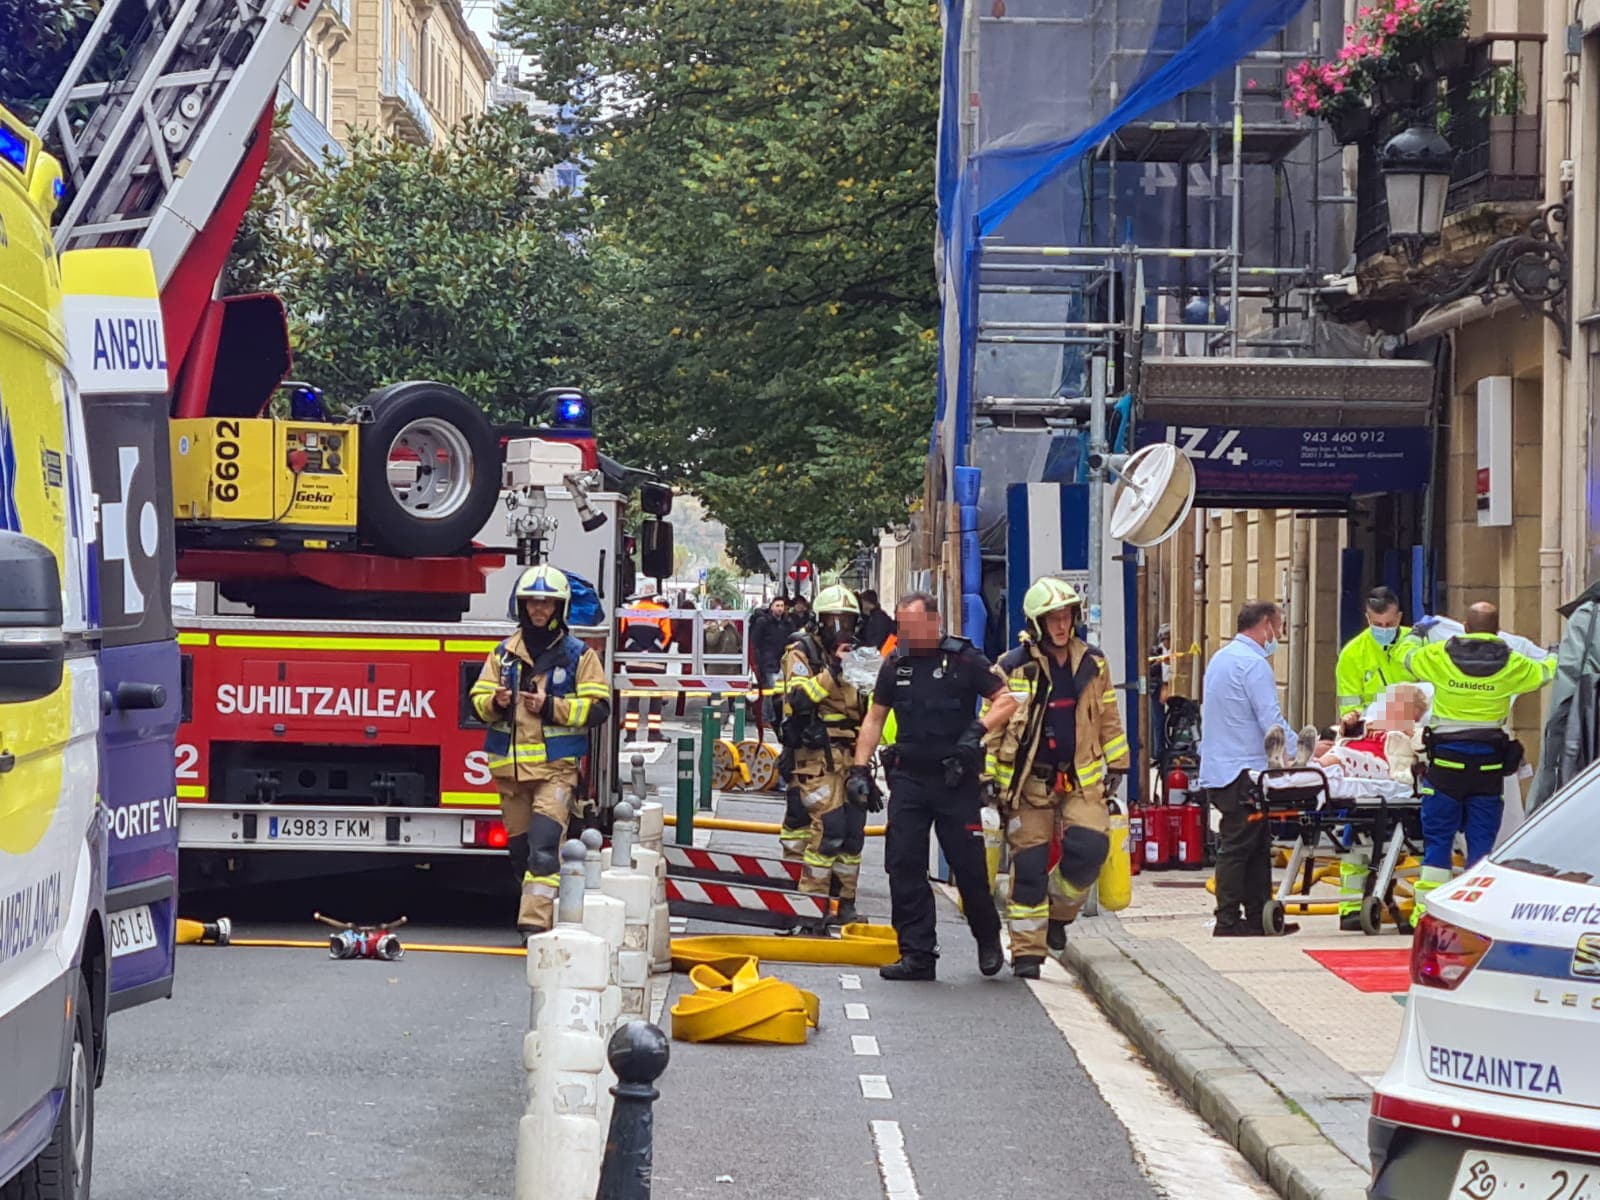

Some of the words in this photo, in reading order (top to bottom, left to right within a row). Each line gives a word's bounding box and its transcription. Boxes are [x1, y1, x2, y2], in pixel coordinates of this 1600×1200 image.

[93, 318, 167, 370] ANBUL
[1303, 432, 1327, 442] 943
[1331, 432, 1357, 442] 460
[1360, 432, 1385, 442] 912
[215, 421, 240, 502] 6602
[296, 491, 333, 502] Geko
[1448, 679, 1496, 692] Osakidetza
[216, 684, 436, 718] SUHILTZAILEAK
[281, 817, 328, 837] 4983
[335, 818, 370, 837] FKM
[1430, 1046, 1562, 1095] ERTZAINTZA
